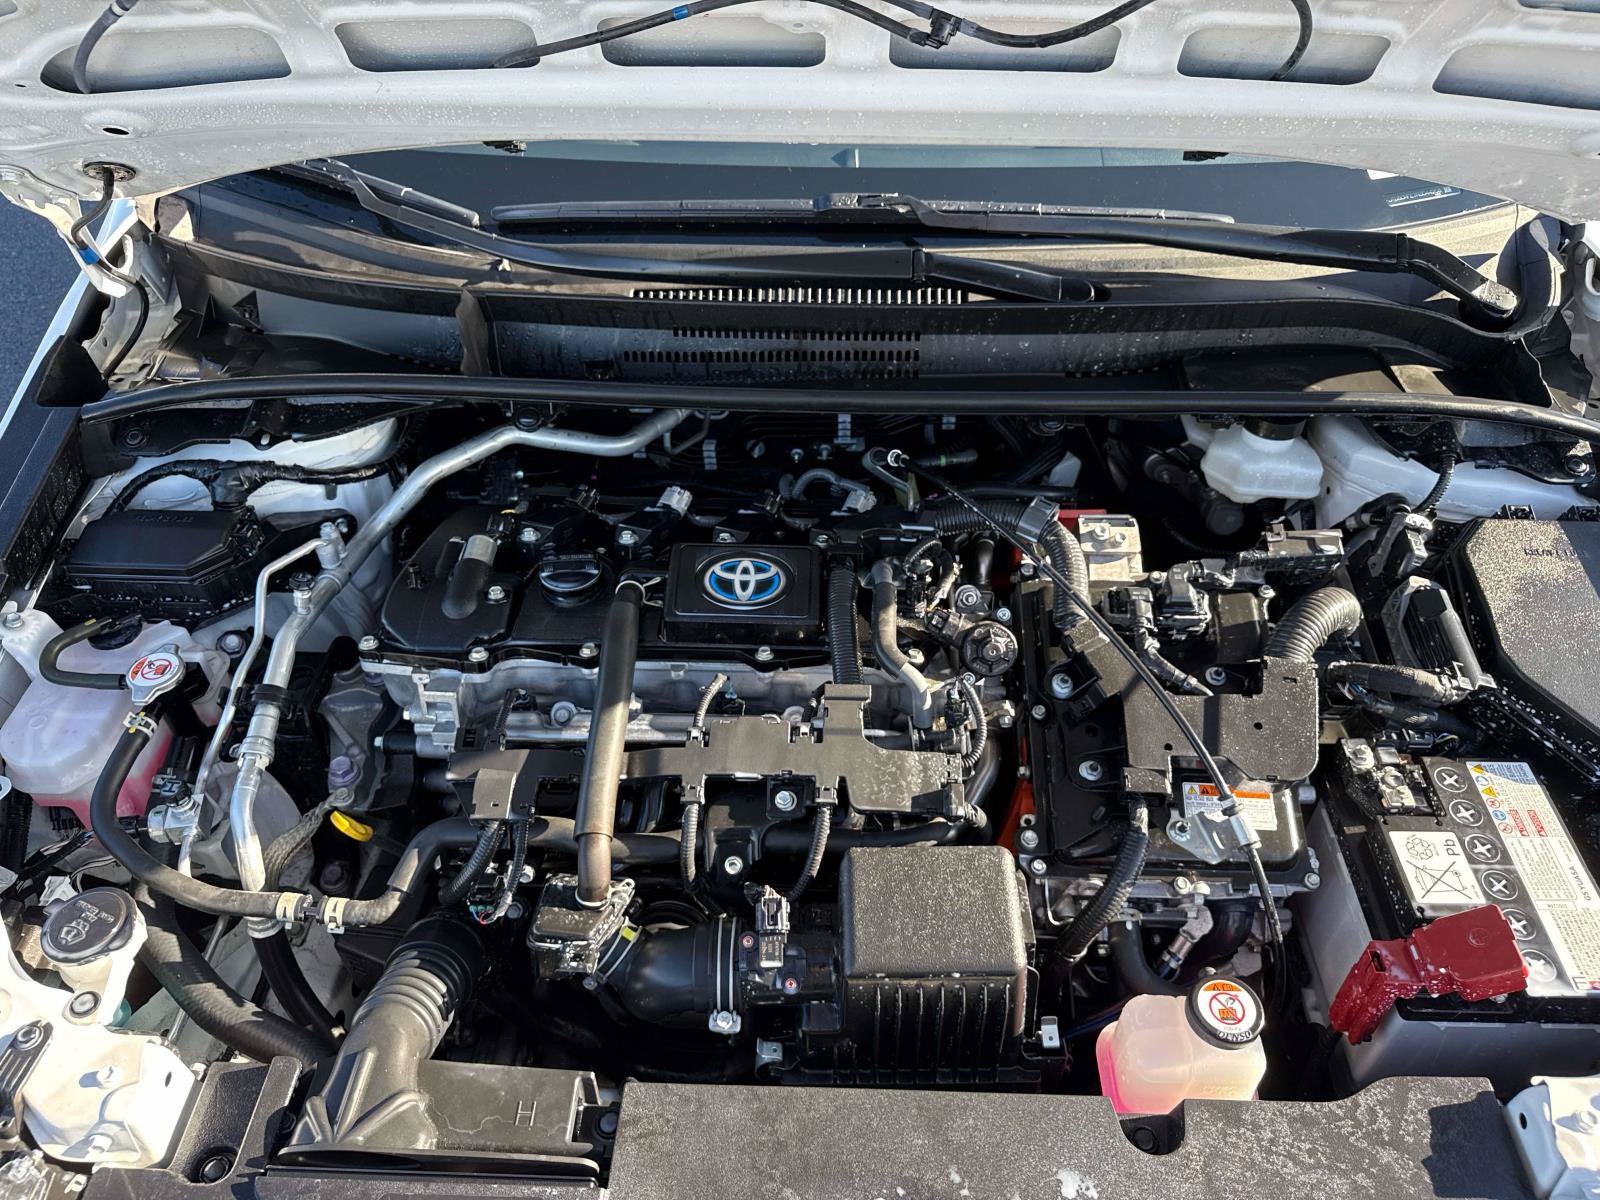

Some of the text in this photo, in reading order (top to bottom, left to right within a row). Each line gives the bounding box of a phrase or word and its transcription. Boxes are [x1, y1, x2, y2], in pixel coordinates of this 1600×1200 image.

[1443, 838, 1460, 857] Pb
[1570, 866, 1592, 902] GS YUASA
[1218, 1030, 1253, 1042] DENSO
[514, 1100, 537, 1126] H
